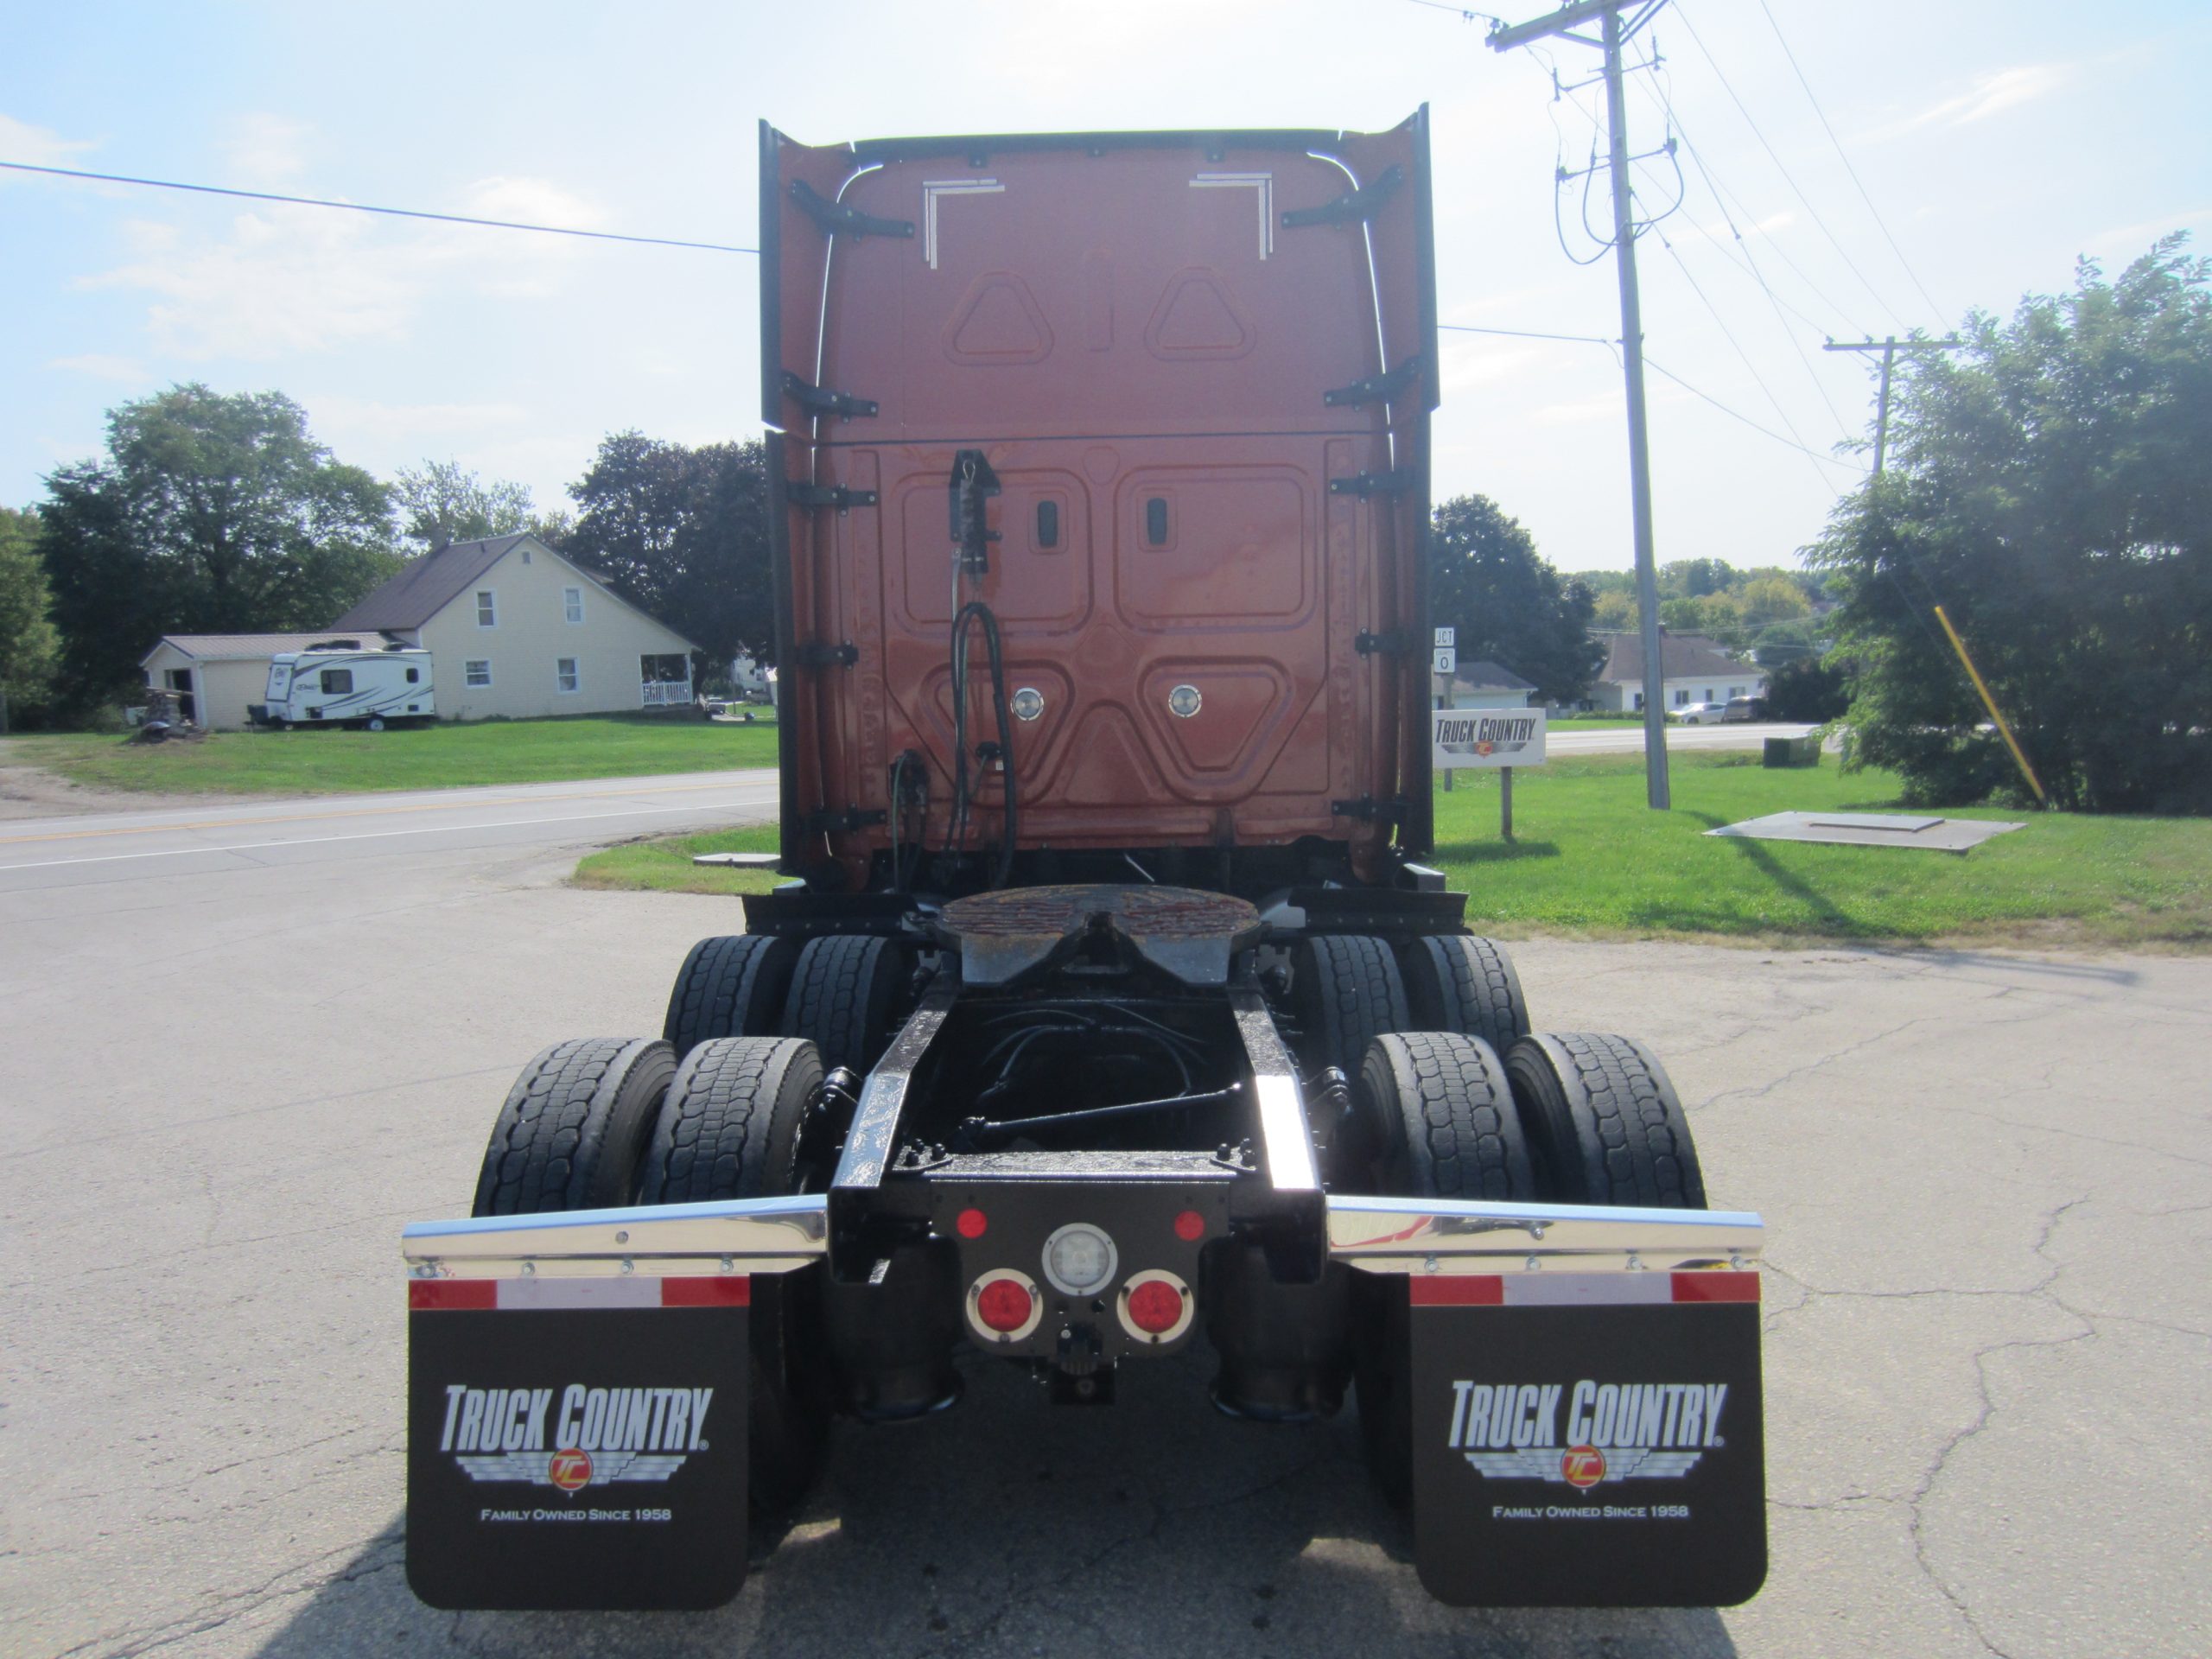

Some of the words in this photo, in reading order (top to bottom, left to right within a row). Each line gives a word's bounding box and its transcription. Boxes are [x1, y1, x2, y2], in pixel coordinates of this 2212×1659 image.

[1436, 631, 1452, 644] JCT
[1435, 719, 1477, 743] TRUCK
[1478, 718, 1536, 741] COUNTRY
[441, 1385, 553, 1452] TRUCK
[556, 1384, 714, 1451] COUNTRY
[1448, 1381, 1562, 1447] TRUCK
[1567, 1380, 1727, 1447] COUNTRY
[480, 1509, 531, 1521] FAMILY
[532, 1509, 586, 1521] OWNED
[588, 1509, 631, 1521] SINCE
[635, 1509, 672, 1521] 1958
[1492, 1505, 1543, 1517] FAMILY
[1545, 1505, 1600, 1517] OWNED
[1603, 1505, 1646, 1517] SINCE
[1650, 1505, 1688, 1517] 1958
